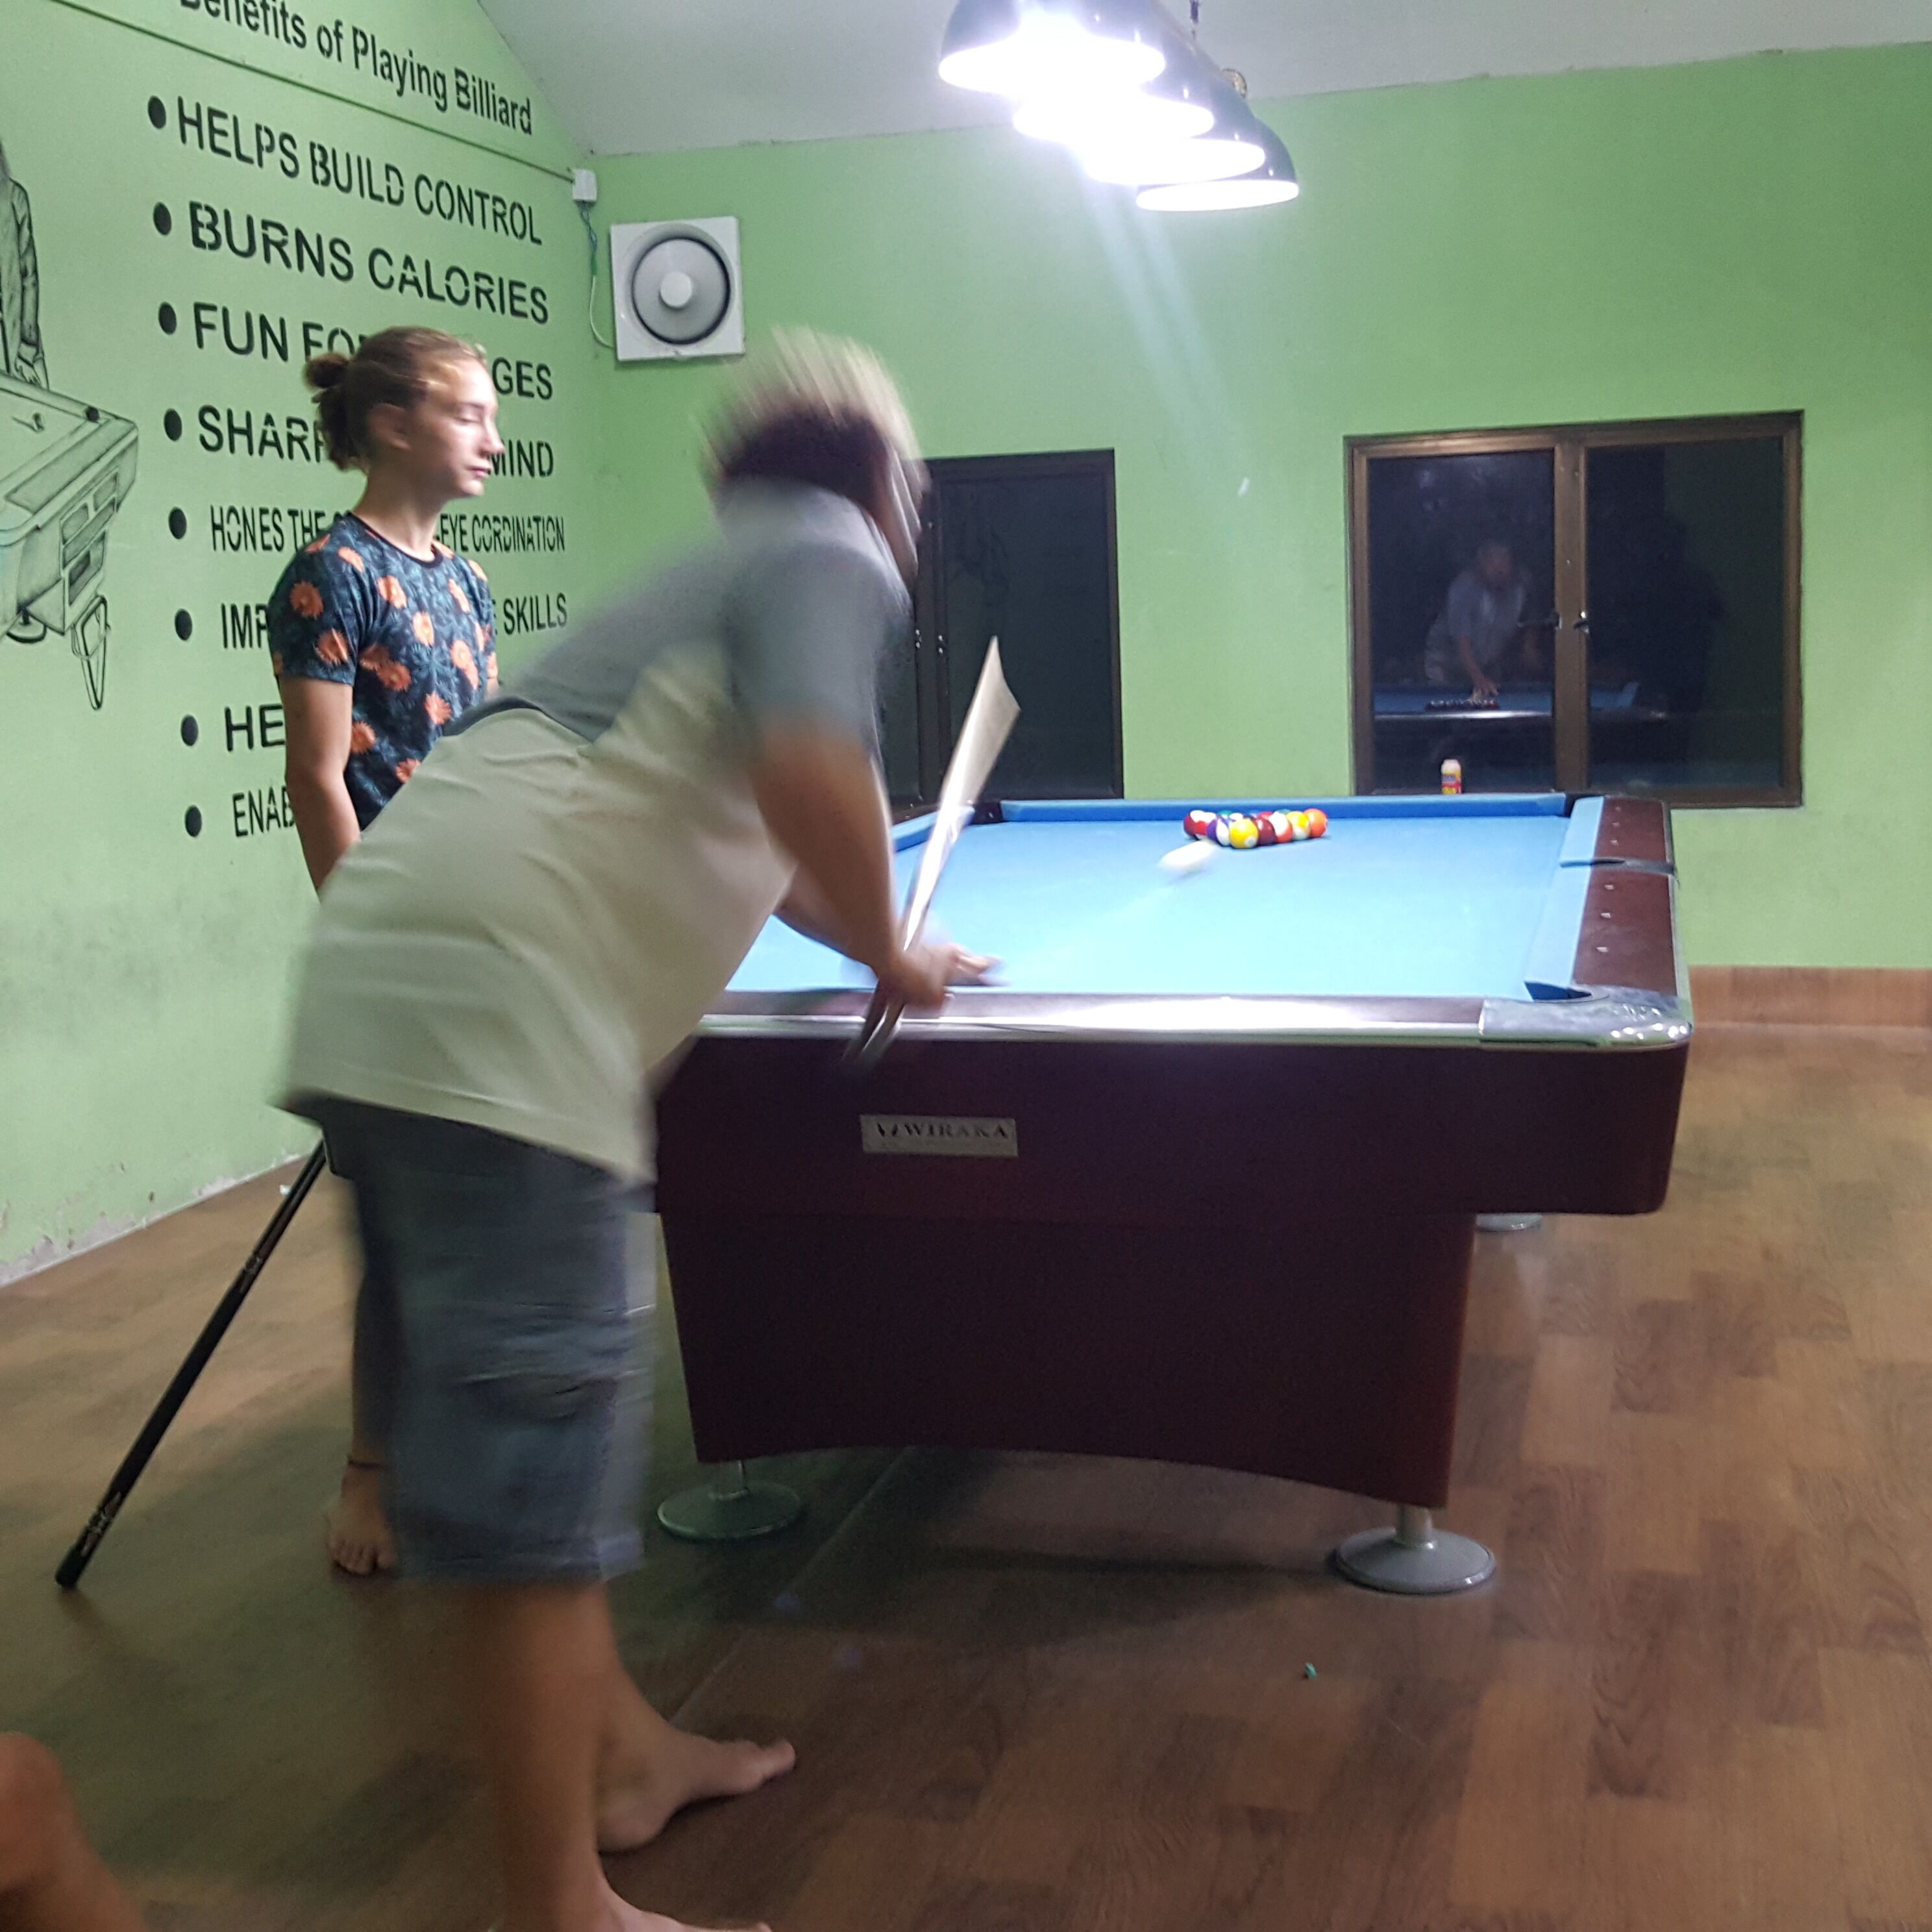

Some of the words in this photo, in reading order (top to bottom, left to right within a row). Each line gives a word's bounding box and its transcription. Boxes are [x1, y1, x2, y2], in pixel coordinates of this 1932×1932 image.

[180, 0, 307, 49] enefits
[317, 19, 343, 62] of
[352, 26, 447, 112] Playing
[454, 66, 532, 135] Billiard
[177, 95, 299, 179] HELPS
[310, 140, 404, 206] BUILD
[414, 173, 543, 245] CONTROL
[189, 201, 354, 282] BURNS
[367, 247, 549, 325] CALORIES
[193, 302, 289, 362] FUN
[303, 321, 367, 361] FO
[210, 505, 284, 552] HONES
[472, 514, 565, 552] CORDINATION
[503, 592, 568, 636] SKILLS
